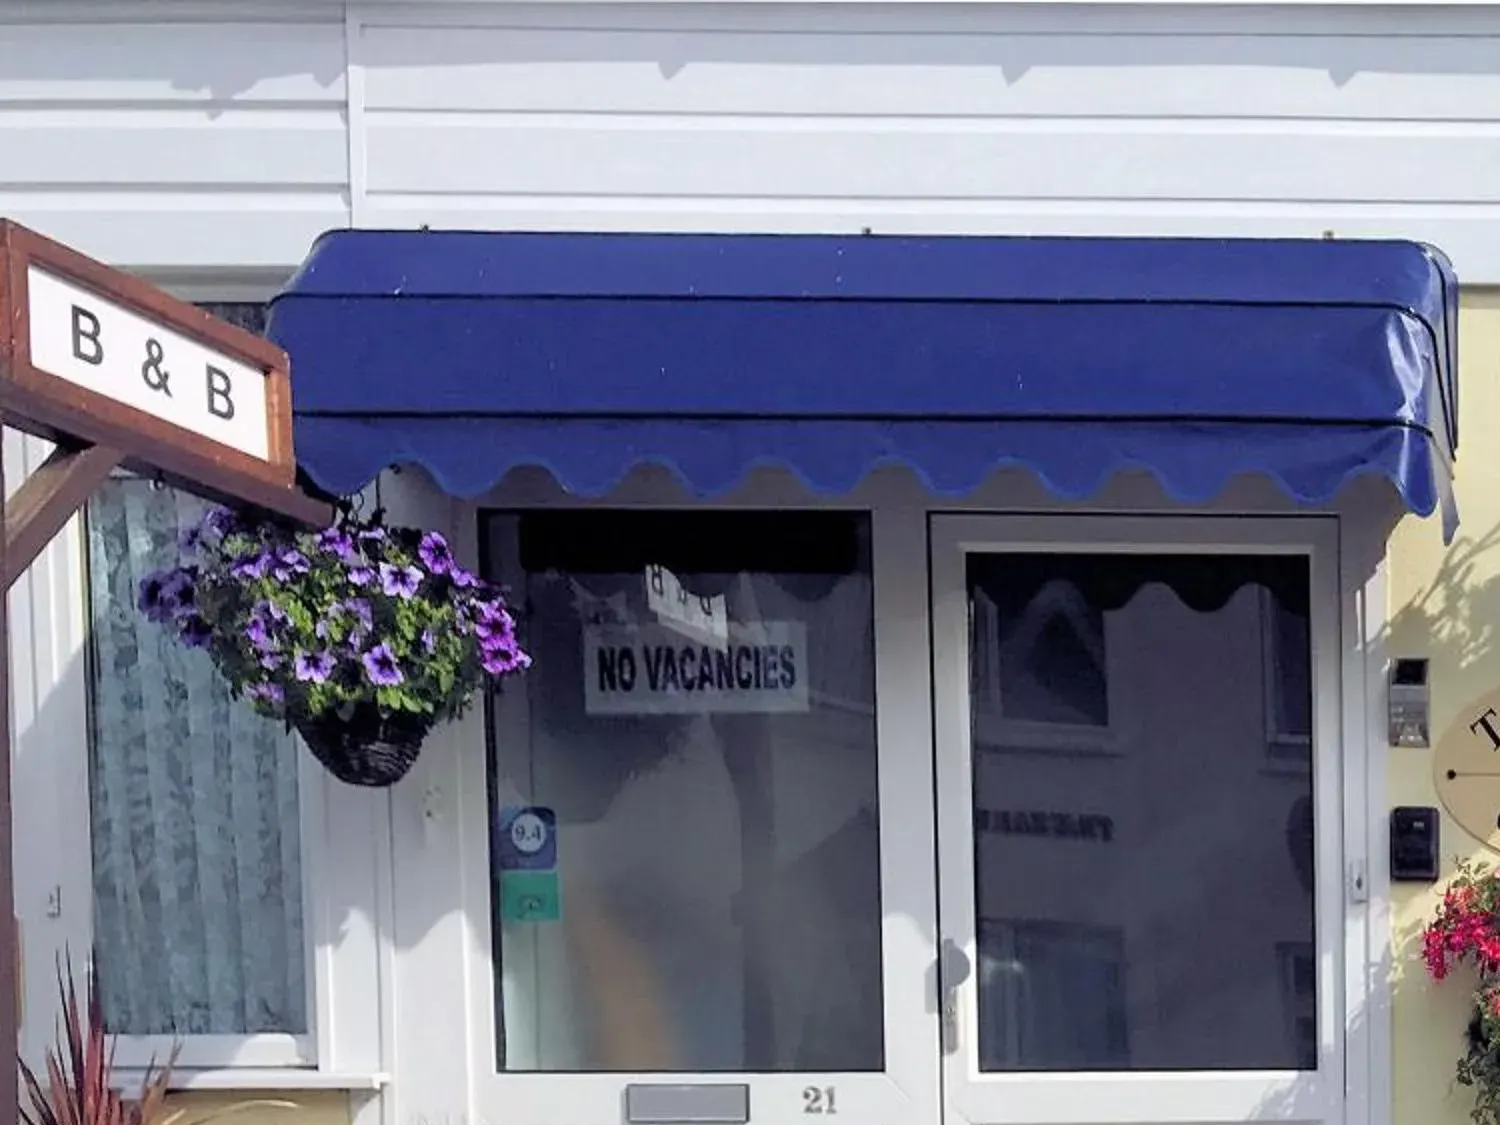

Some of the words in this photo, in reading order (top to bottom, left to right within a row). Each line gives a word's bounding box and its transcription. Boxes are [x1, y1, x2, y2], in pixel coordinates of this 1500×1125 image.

[72, 304, 103, 365] B
[141, 338, 173, 398] &
[206, 362, 235, 421] B
[598, 646, 637, 692] NO
[643, 645, 796, 692] VACANCIES
[802, 1086, 837, 1114] 21
